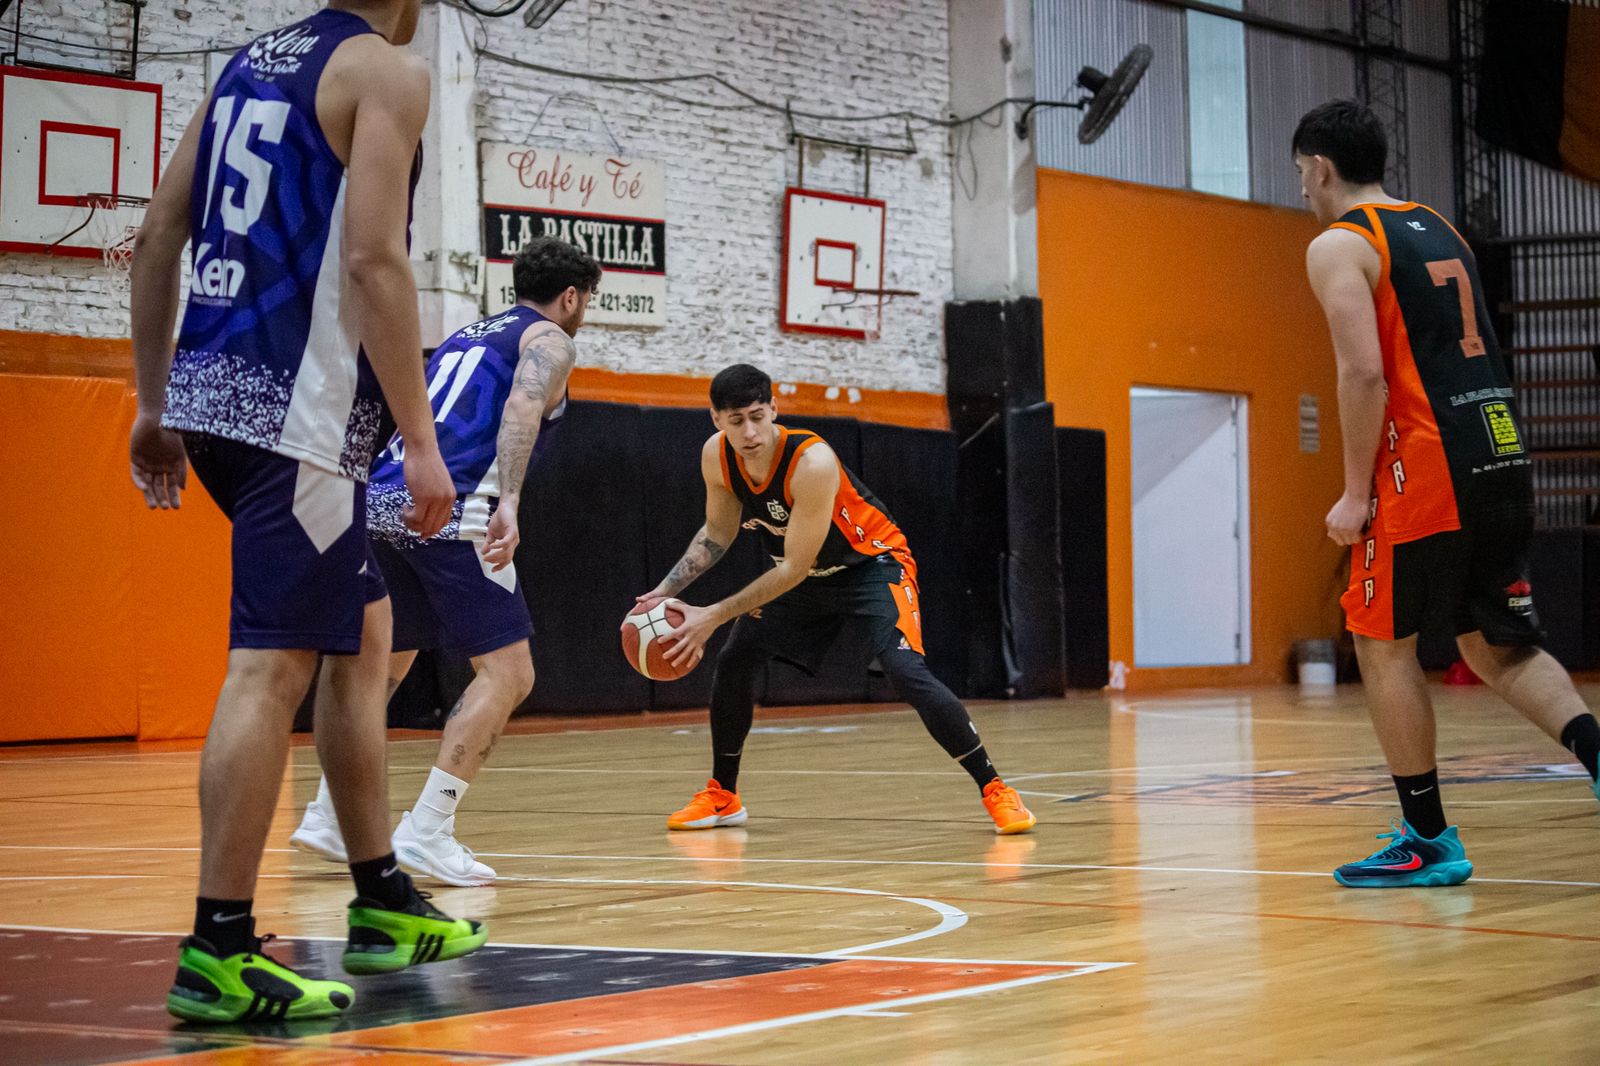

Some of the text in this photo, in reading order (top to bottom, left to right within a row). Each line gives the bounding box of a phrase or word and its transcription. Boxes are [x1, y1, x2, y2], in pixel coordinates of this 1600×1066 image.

[202, 95, 291, 236] 15
[507, 150, 642, 207] Café y Té
[500, 213, 532, 255] LA
[599, 293, 655, 313] 421-3972
[1425, 258, 1486, 358] 7
[428, 346, 487, 422] 11
